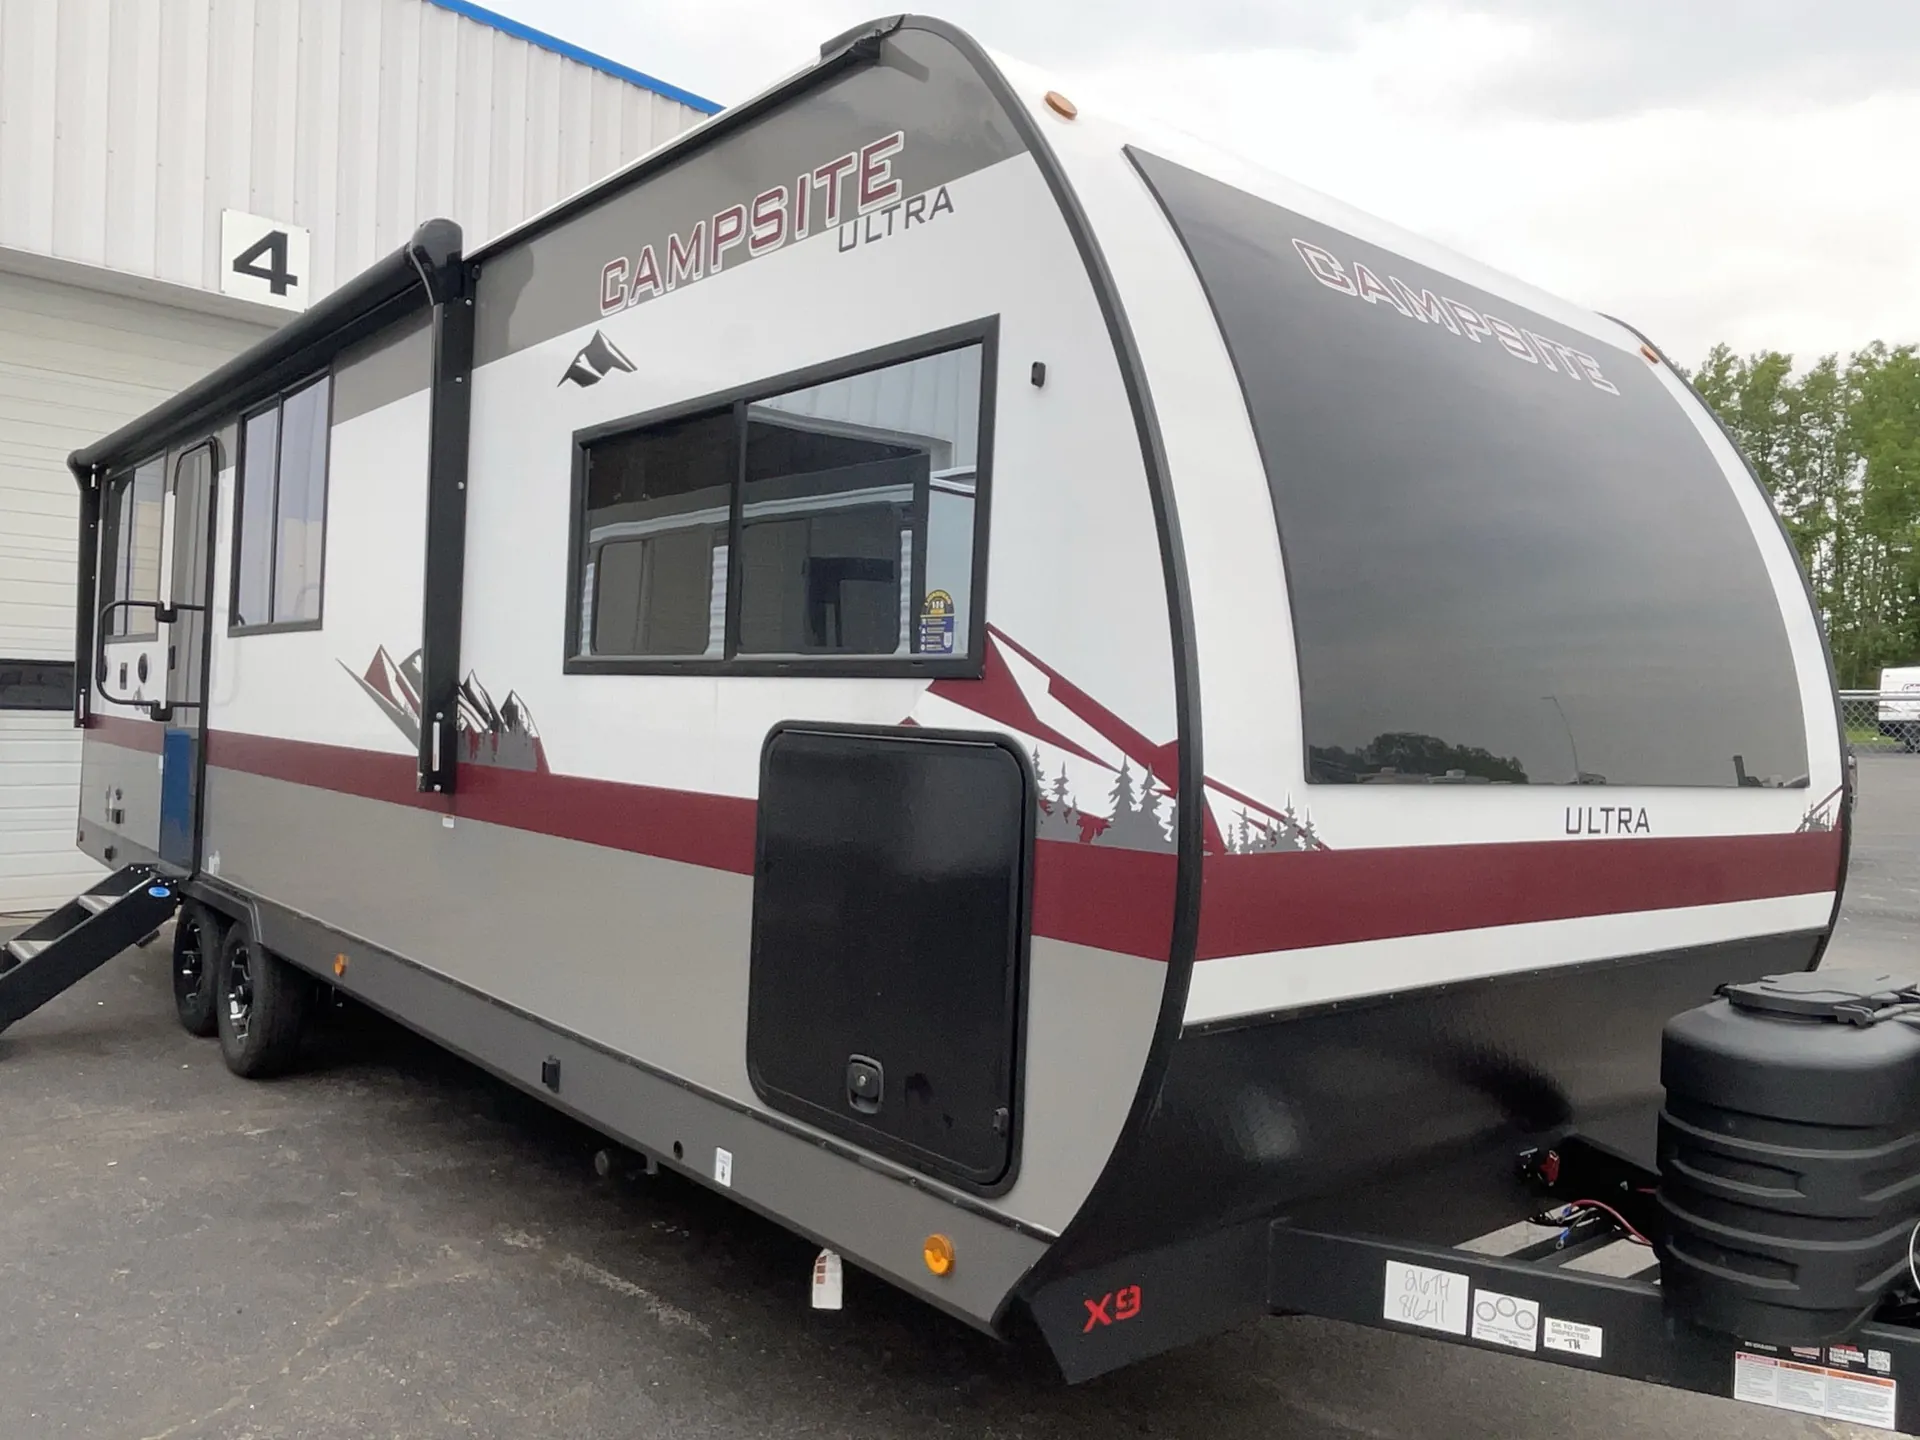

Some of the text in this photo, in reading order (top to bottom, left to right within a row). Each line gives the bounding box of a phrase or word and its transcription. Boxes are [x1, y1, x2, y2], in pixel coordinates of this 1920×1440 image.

[601, 130, 905, 317] CAMPSITE
[838, 186, 954, 253] ULTRA
[232, 229, 298, 297] 4
[1292, 238, 1621, 396] CAMPSITE
[1566, 807, 1650, 834] ULTRA
